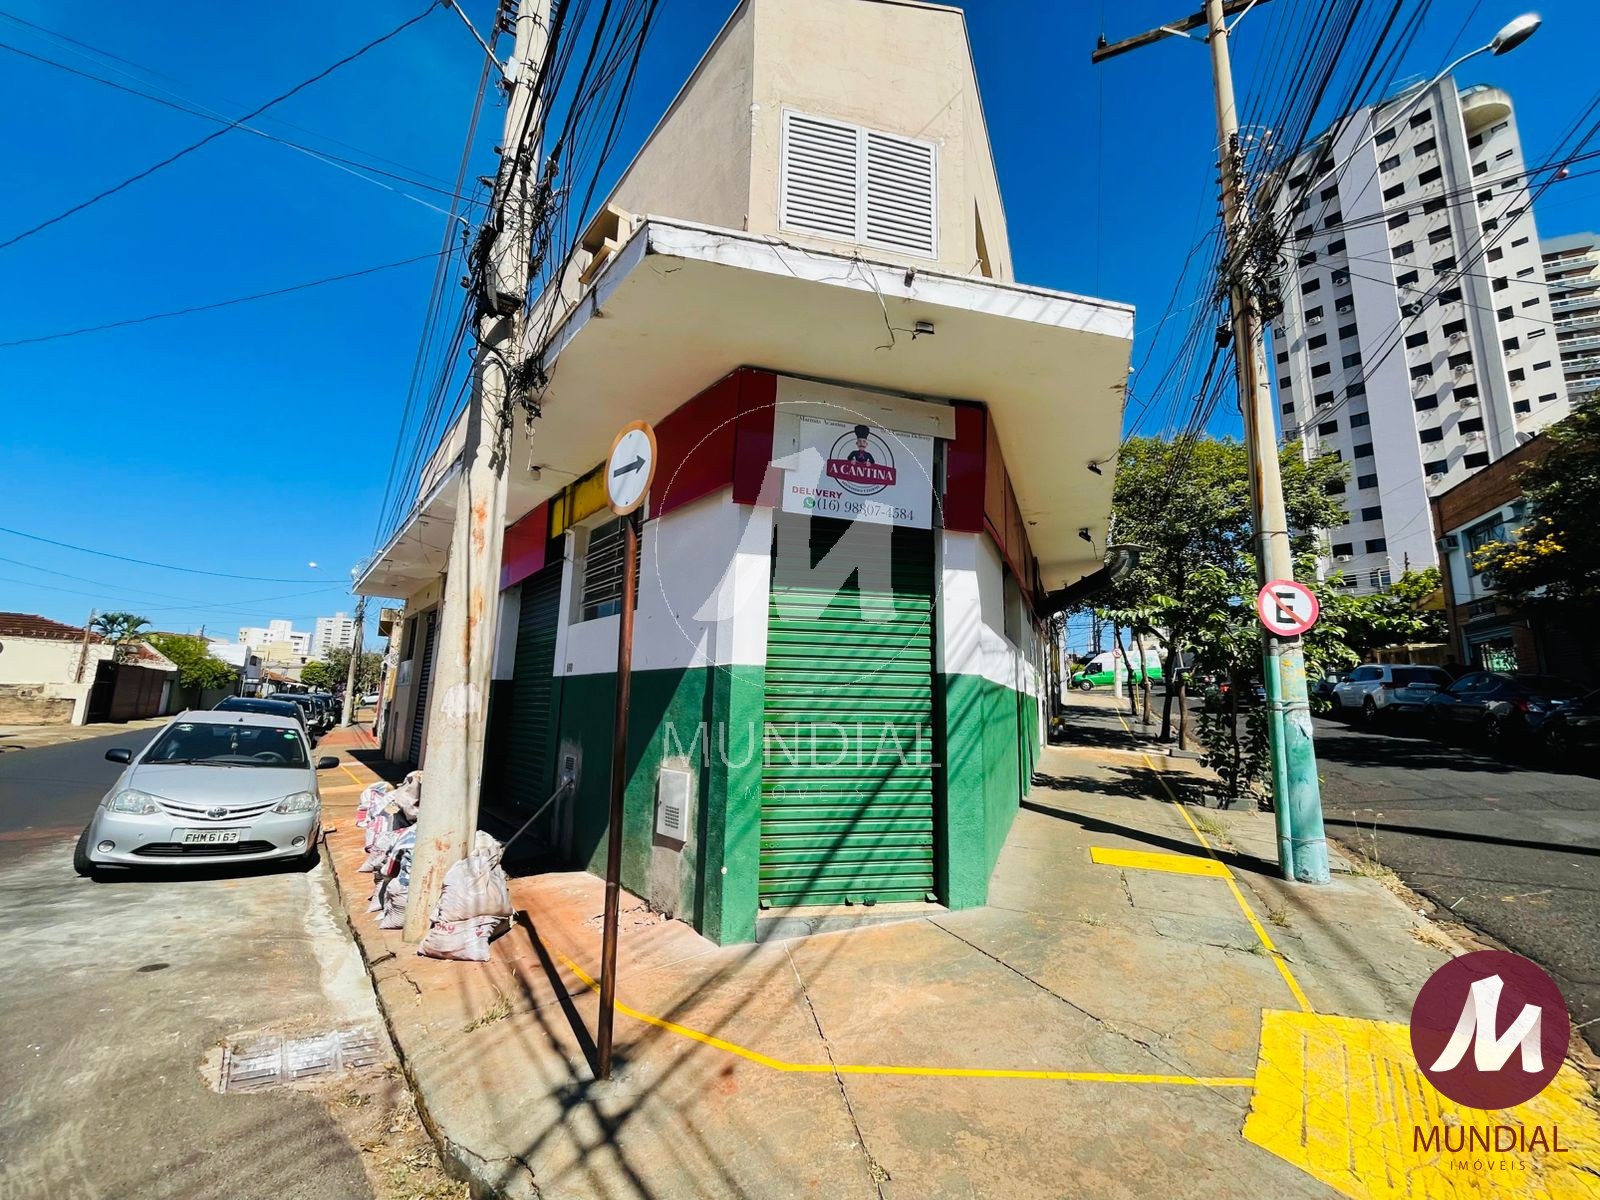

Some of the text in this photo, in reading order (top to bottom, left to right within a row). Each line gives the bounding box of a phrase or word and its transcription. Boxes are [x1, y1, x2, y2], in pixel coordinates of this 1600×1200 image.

[830, 463, 893, 481] A CANTINA
[792, 486, 843, 499] DELIVERY
[817, 498, 913, 521] (16) 98807-4584
[1275, 592, 1297, 624] E
